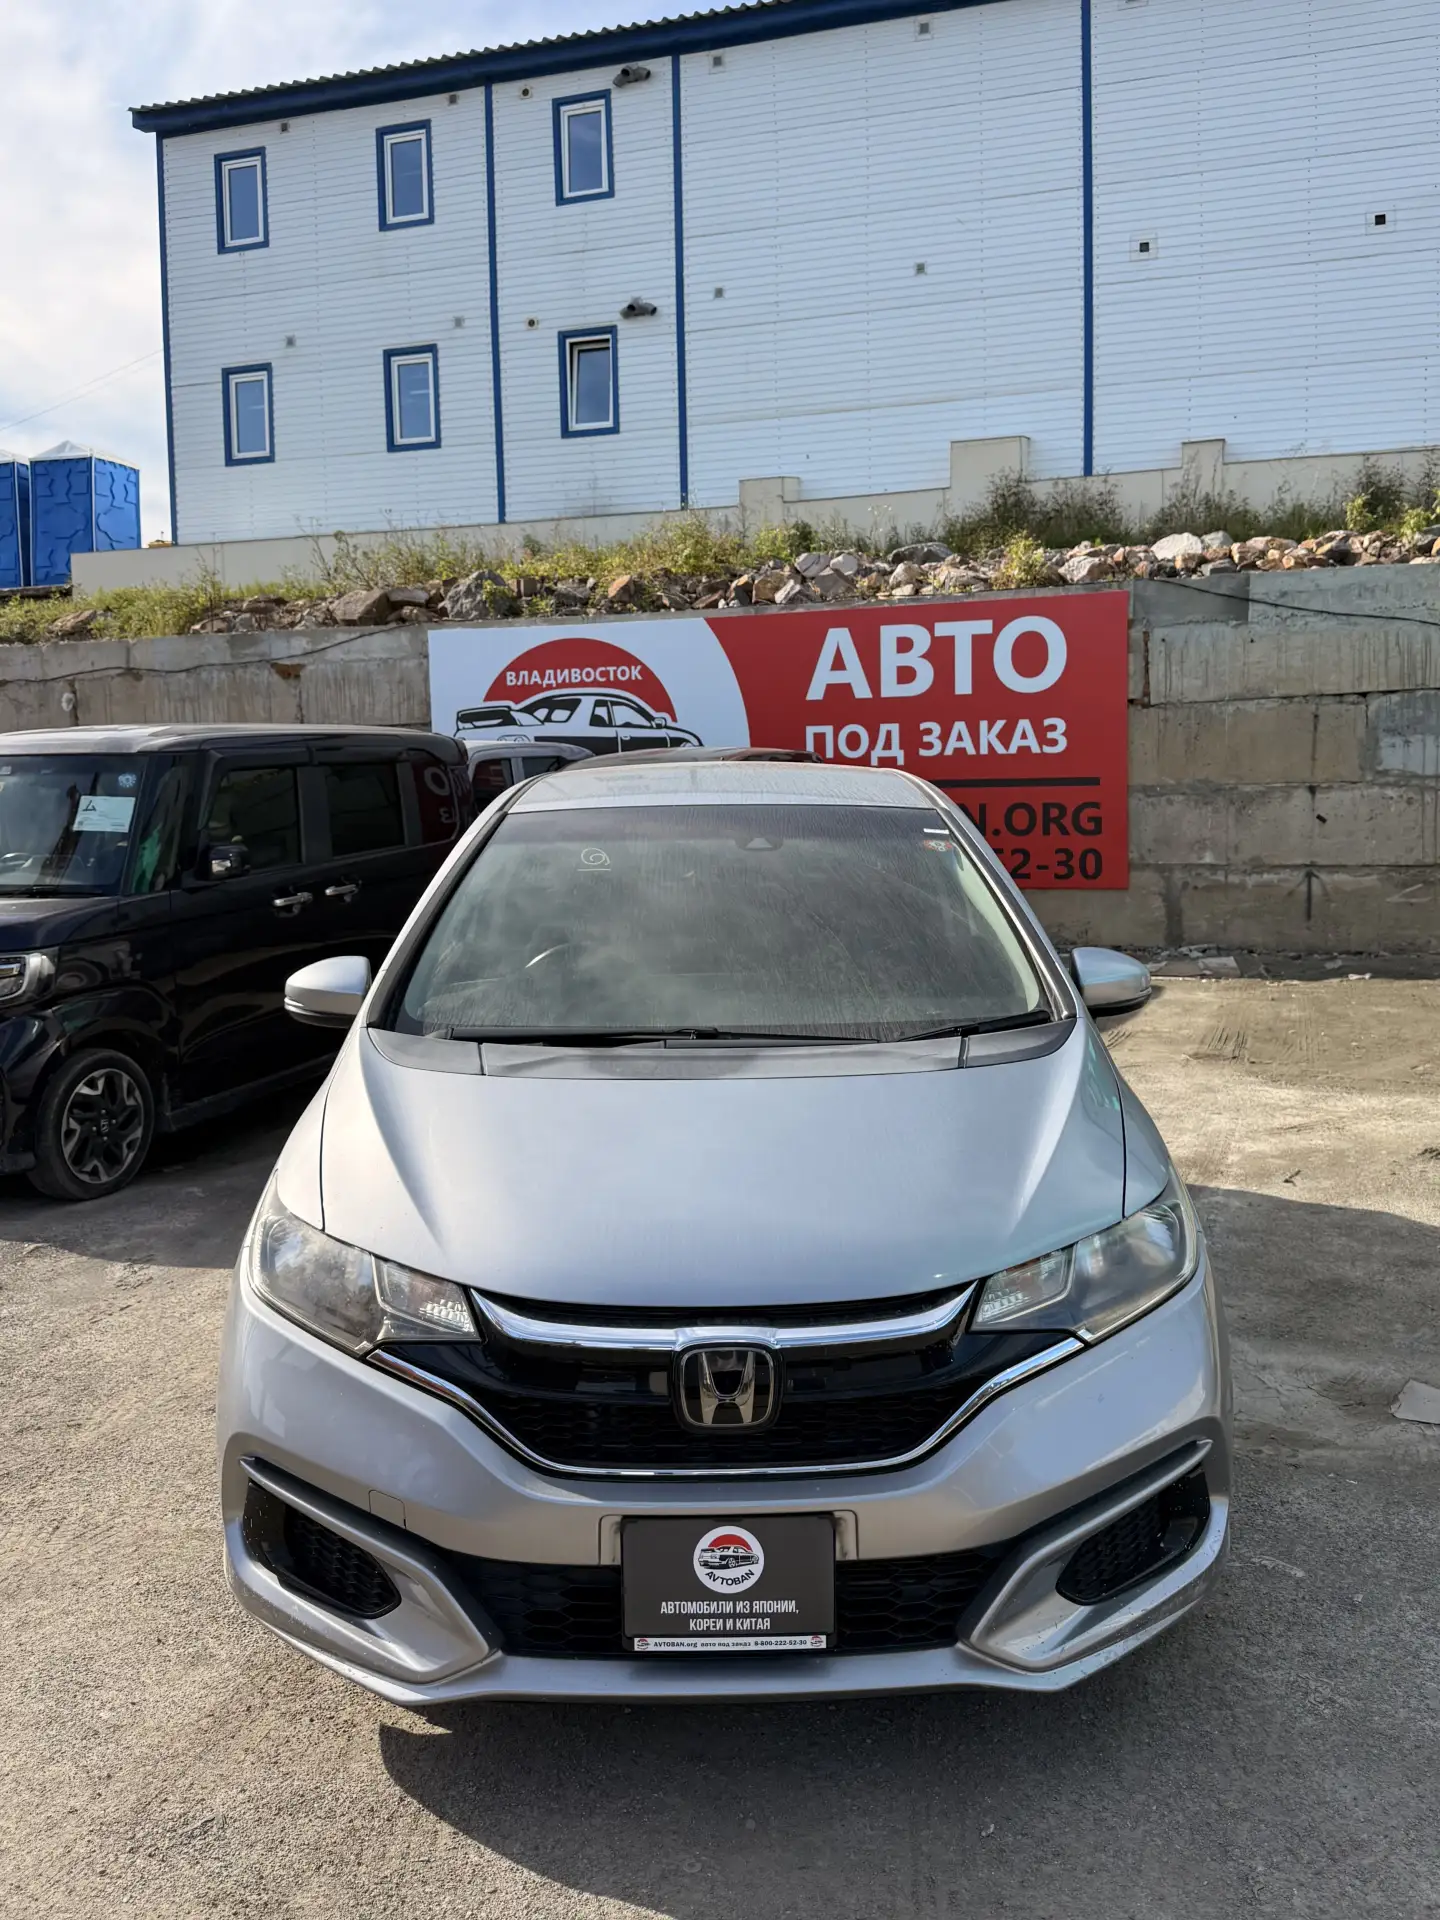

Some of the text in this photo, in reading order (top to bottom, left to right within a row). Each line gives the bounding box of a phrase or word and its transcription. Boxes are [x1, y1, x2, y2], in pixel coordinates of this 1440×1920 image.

[805, 615, 1067, 700] АВТО
[505, 664, 643, 688] ВЛАДИВОСТОК
[805, 717, 1068, 767] ПОД ЗАКАЗ
[704, 1568, 756, 1586] AVTOBAN
[660, 1599, 799, 1615] АВТОМОБИЛИ ИЗ ЯПОНИИ,
[689, 1617, 771, 1631] КОРЕИ И КИТАЯ
[754, 1639, 808, 1647] 8-800-222-52-30
